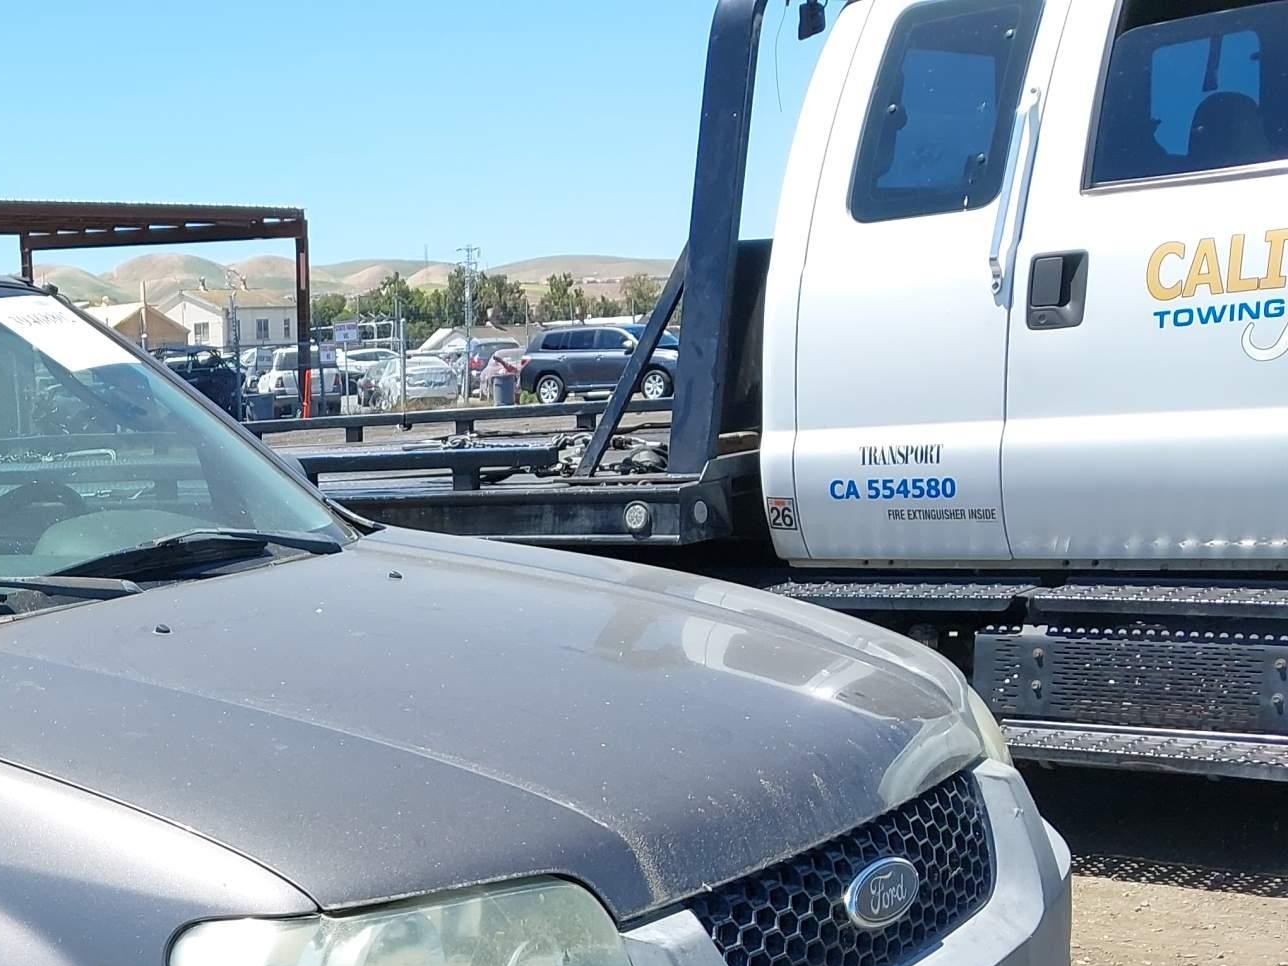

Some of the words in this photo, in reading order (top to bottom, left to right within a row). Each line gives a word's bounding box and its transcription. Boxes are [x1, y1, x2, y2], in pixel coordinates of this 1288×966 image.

[1153, 299, 1286, 329] TOWING
[858, 443, 944, 466] TRANSPORT
[830, 479, 860, 500] CA
[867, 477, 956, 499] 554580
[770, 506, 794, 527] 26
[887, 509, 906, 521] FIRE
[907, 508, 966, 521] EXTINGUISHER
[968, 508, 997, 520] INSIDE
[869, 870, 908, 915] Ford
